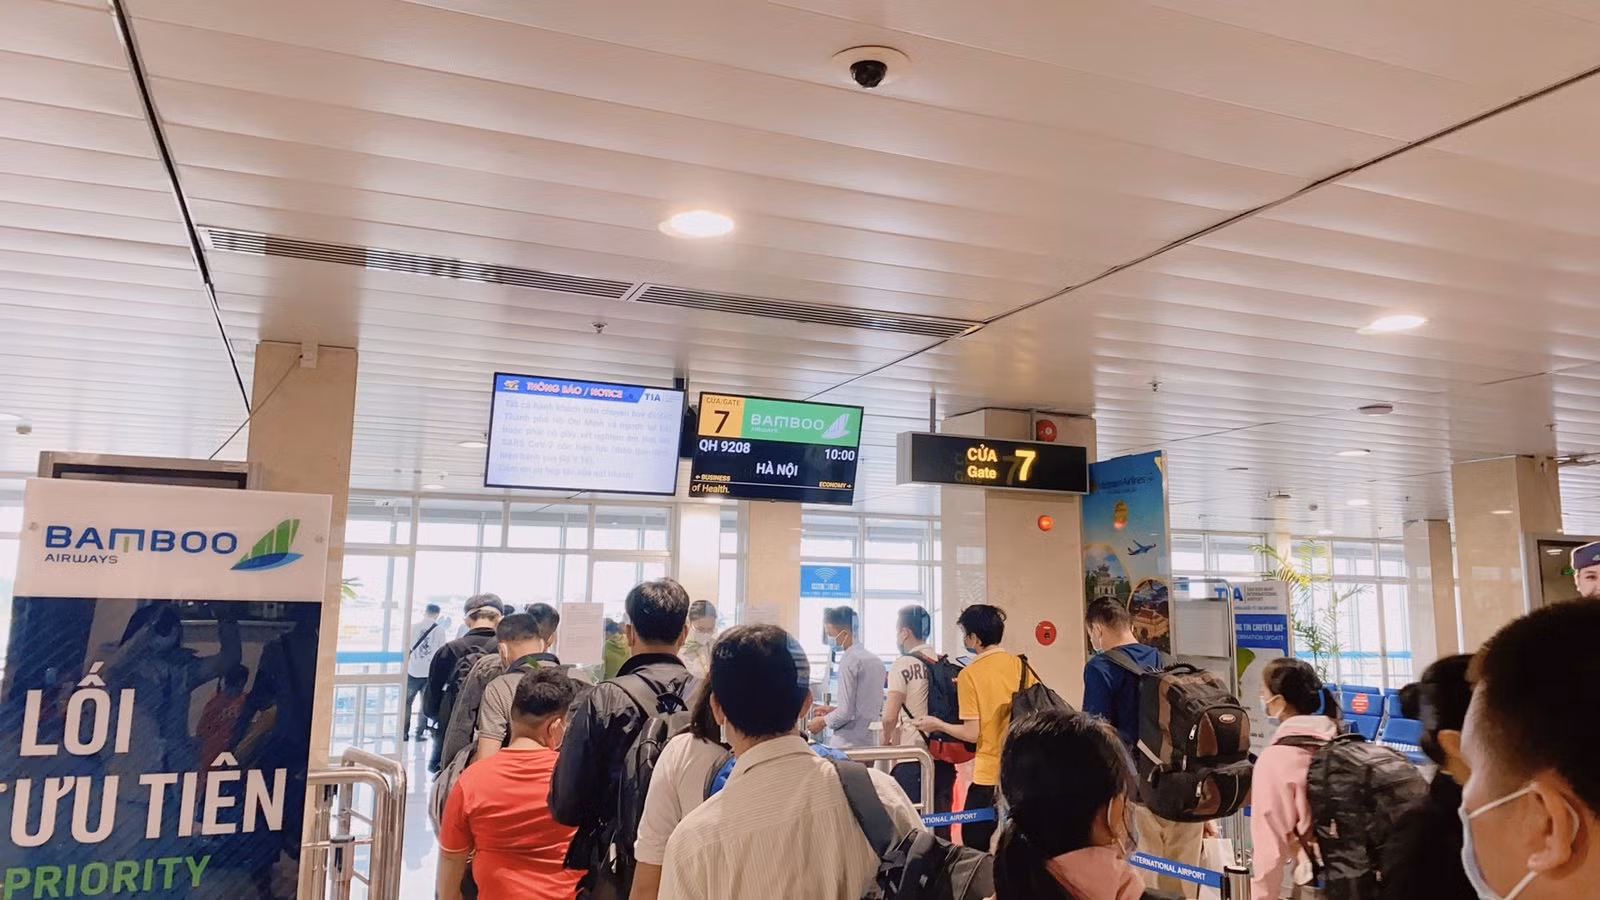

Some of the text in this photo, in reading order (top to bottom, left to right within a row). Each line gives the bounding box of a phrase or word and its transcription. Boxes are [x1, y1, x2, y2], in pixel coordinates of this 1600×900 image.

[526, 381, 560, 394] THÔNG
[562, 384, 582, 397] BÁO
[590, 388, 624, 399] NOTICE
[644, 393, 661, 402] TIA
[714, 410, 730, 434] 7
[751, 413, 824, 431] BAMBOO
[699, 439, 751, 454] QH 9208
[824, 448, 855, 461] 10:00
[967, 444, 998, 462] CỬA
[756, 461, 799, 478] HÀ NỘI
[967, 466, 997, 479] Gate
[1015, 449, 1036, 481] 7
[691, 484, 730, 493] of Health.
[819, 481, 847, 489] ECONOMY
[45, 525, 238, 555] BAMBOO
[44, 553, 119, 565] AIRWAYS
[19, 661, 136, 757] LỐI
[11, 752, 288, 847] ƯU TIÊN
[949, 812, 977, 822] AIRPORT
[4, 855, 212, 900] PRIORITY
[1177, 867, 1207, 880] AIRPORT
